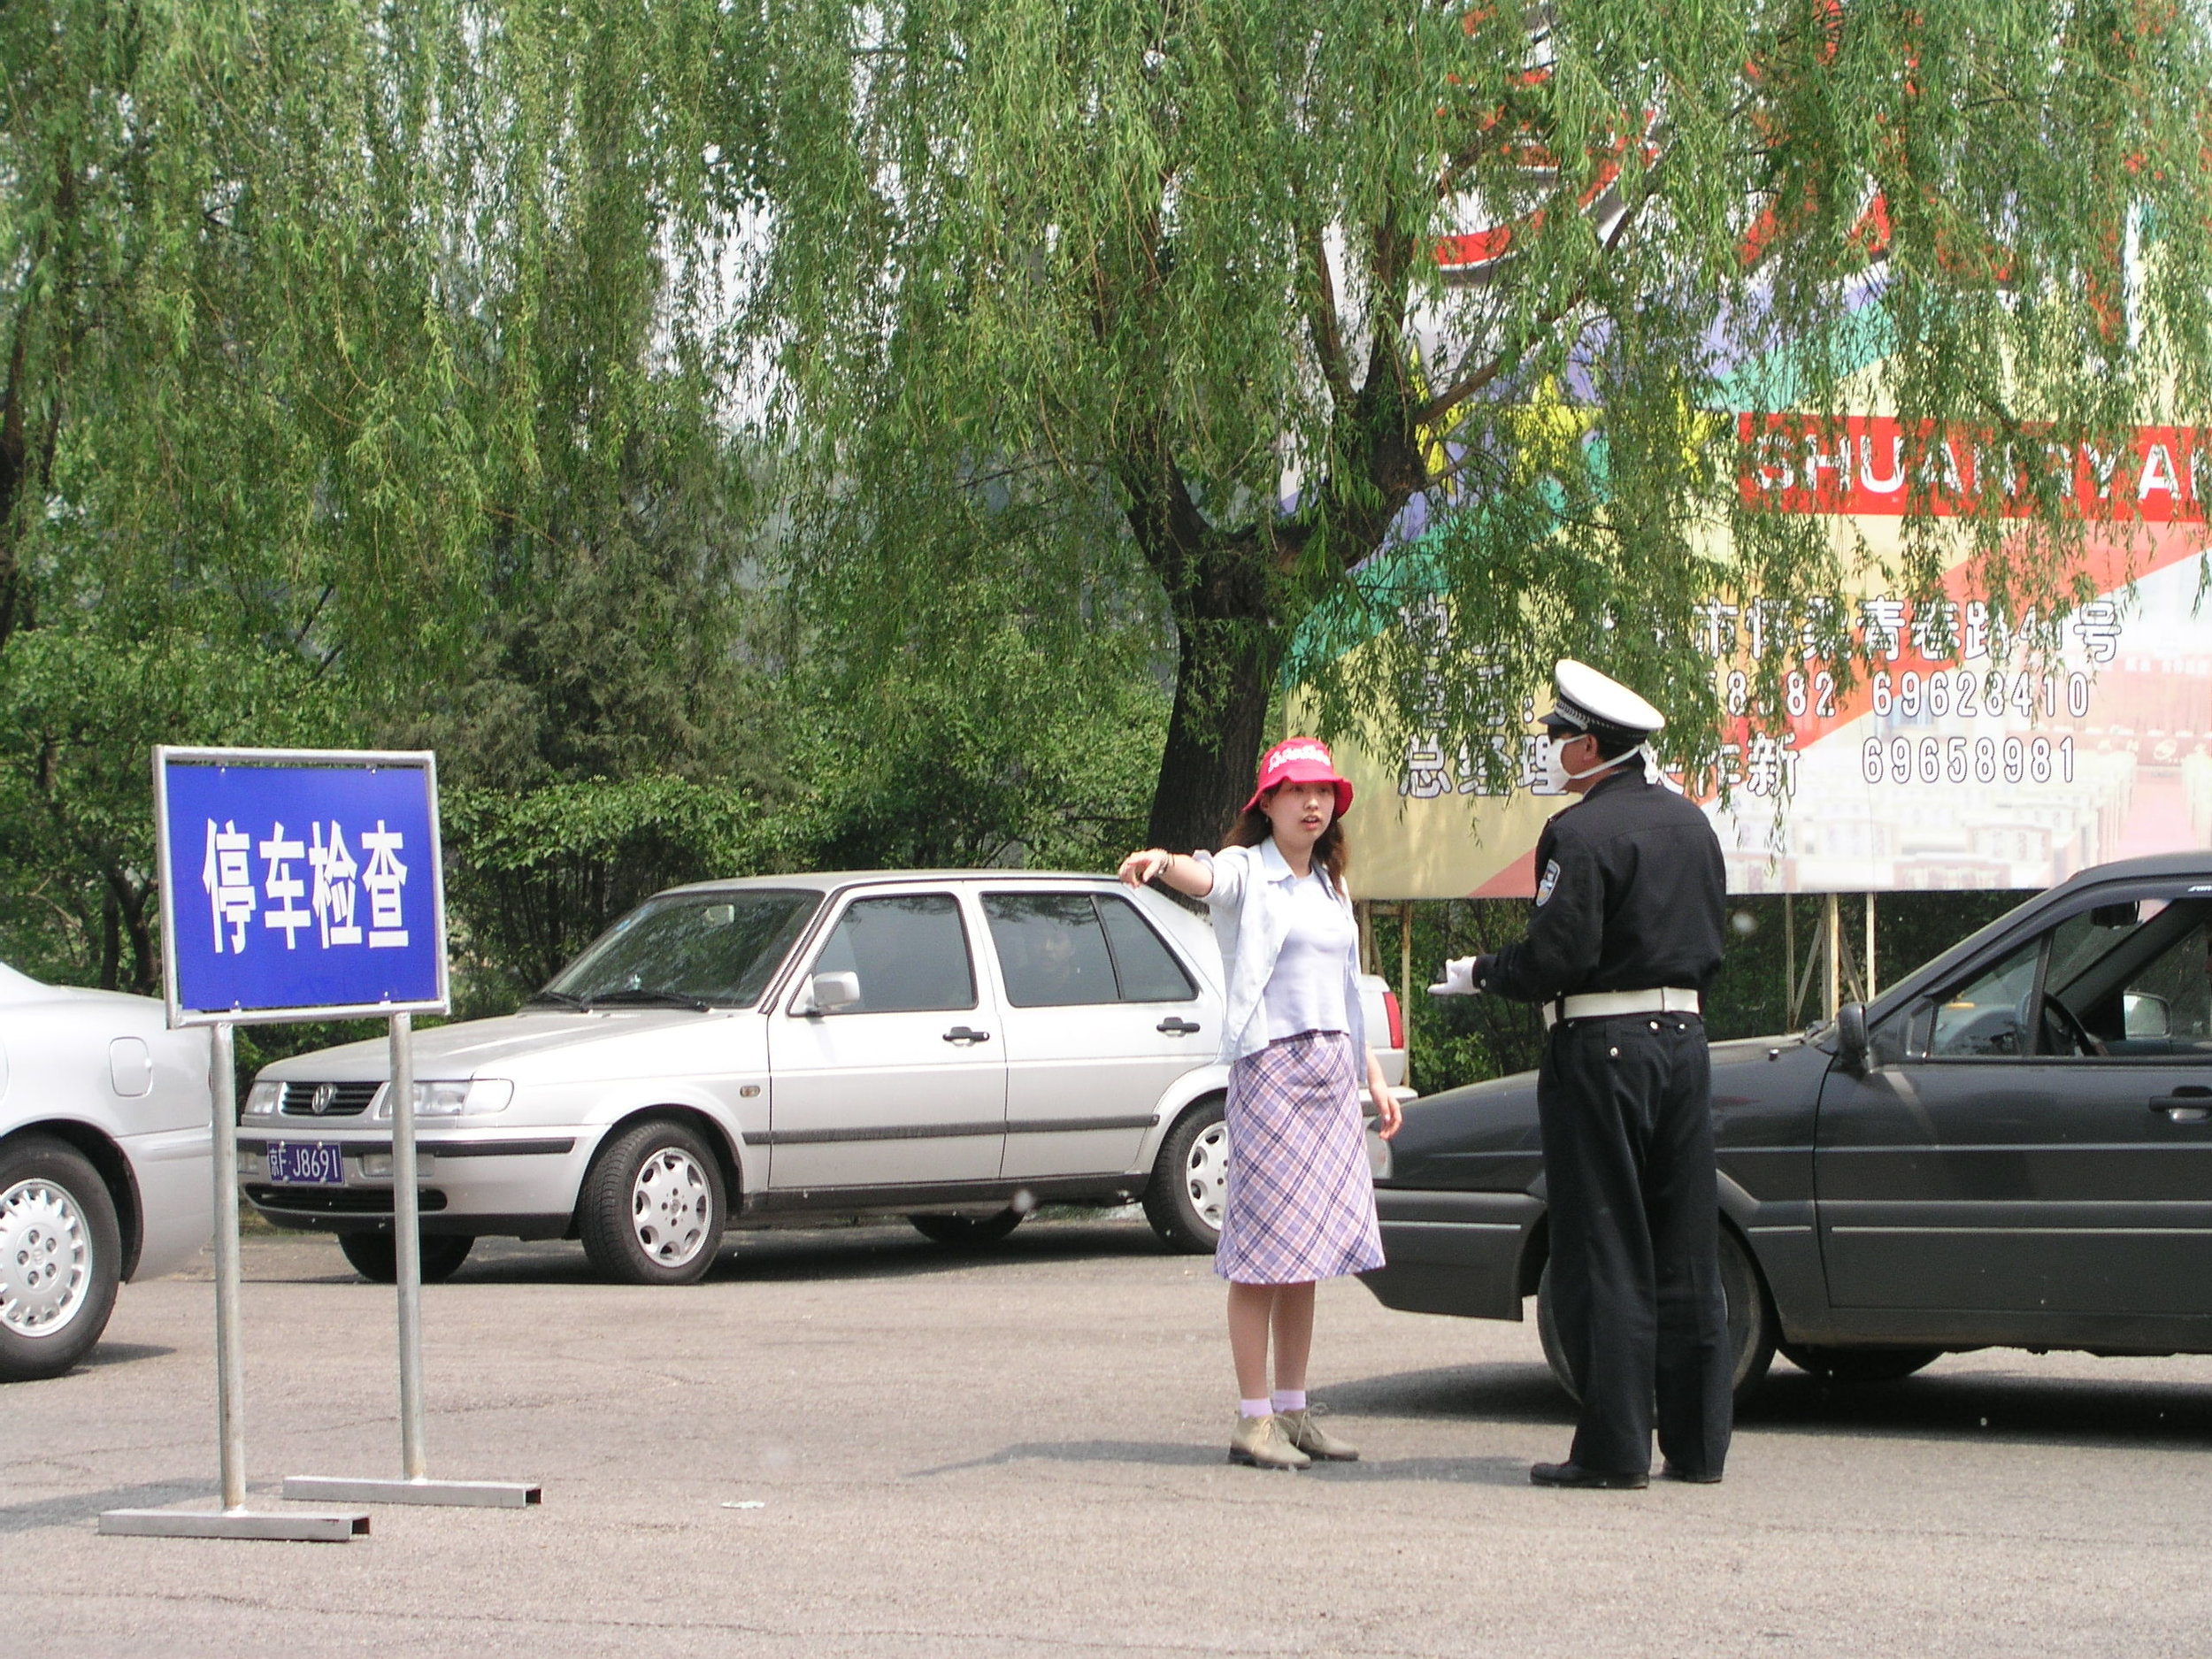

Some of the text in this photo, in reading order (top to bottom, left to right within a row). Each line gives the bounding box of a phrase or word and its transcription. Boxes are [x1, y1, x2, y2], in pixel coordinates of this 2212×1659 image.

[1872, 670, 2090, 718] 69628410
[1862, 735, 2075, 785] 69658981
[202, 818, 410, 955] 停车检查
